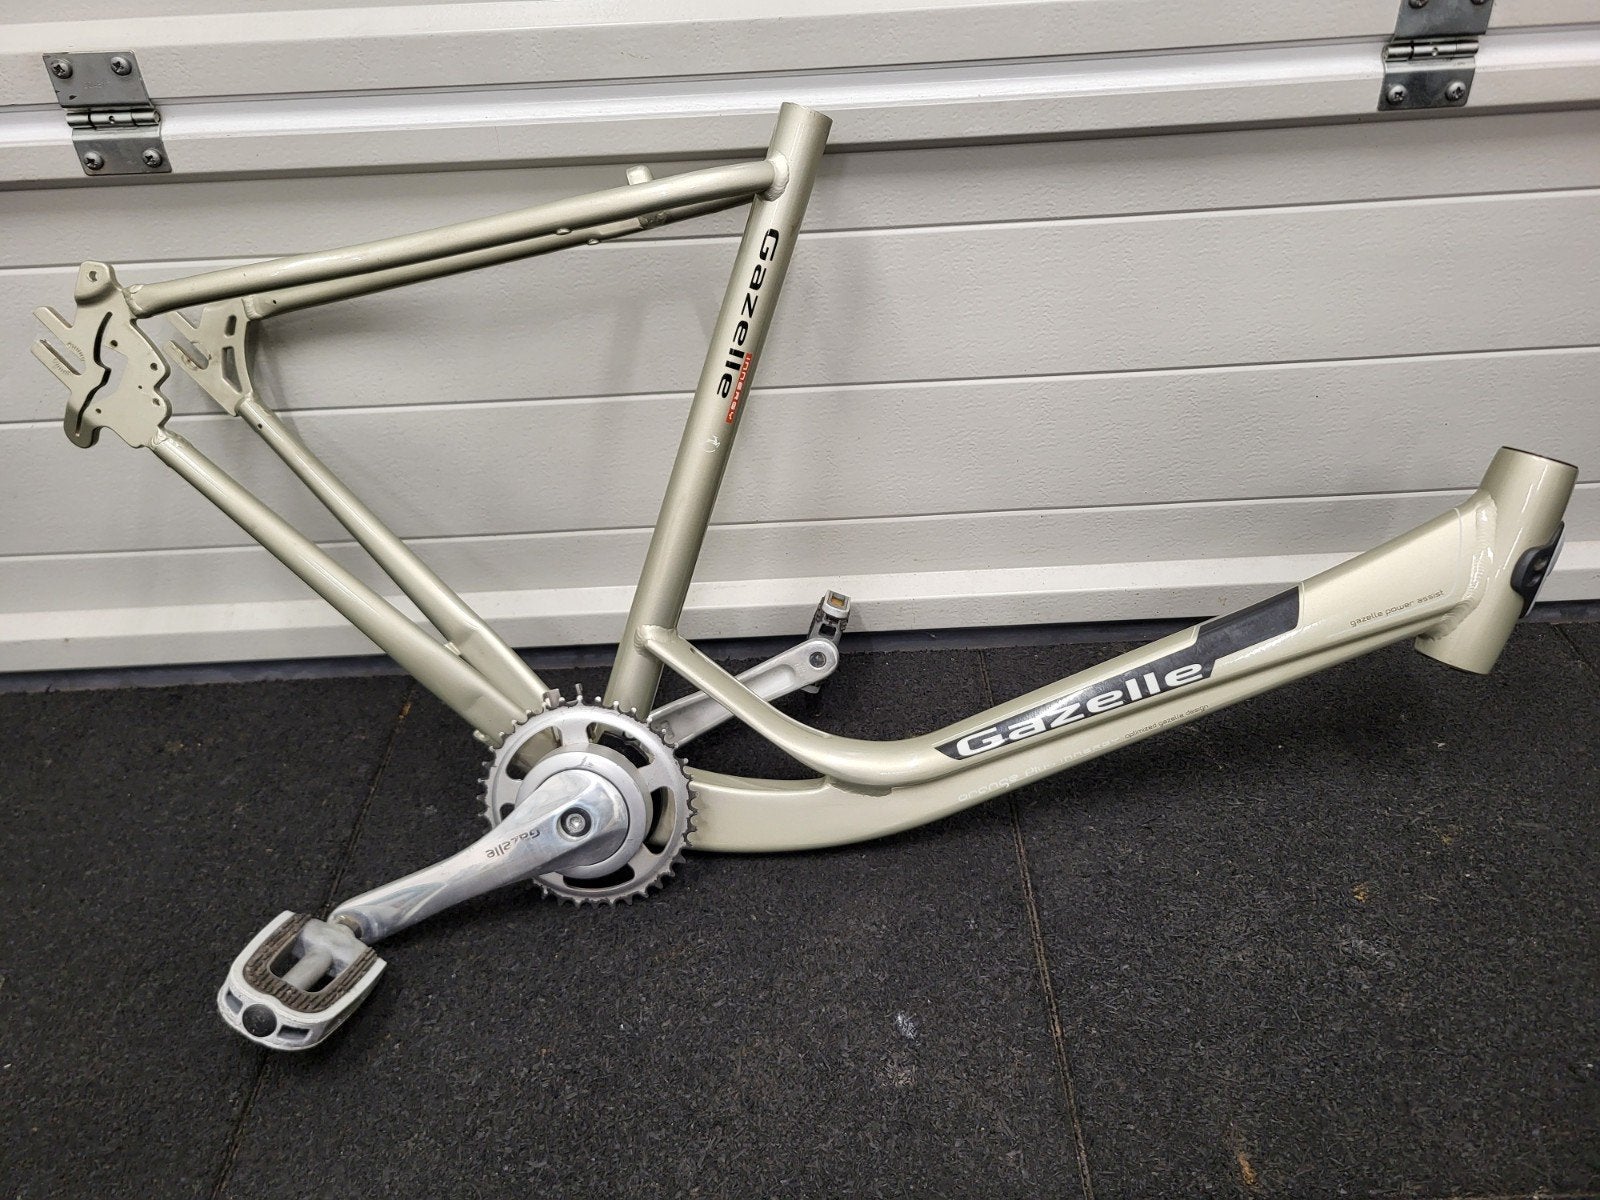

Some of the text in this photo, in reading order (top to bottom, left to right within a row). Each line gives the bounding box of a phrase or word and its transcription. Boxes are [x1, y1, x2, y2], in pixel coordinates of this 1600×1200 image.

[717, 228, 780, 399] Gazelle
[1350, 589, 1445, 628] gazelle power assist
[956, 663, 1203, 758] Gazelle
[1185, 704, 1209, 716] design
[485, 827, 541, 859] Gazelle
